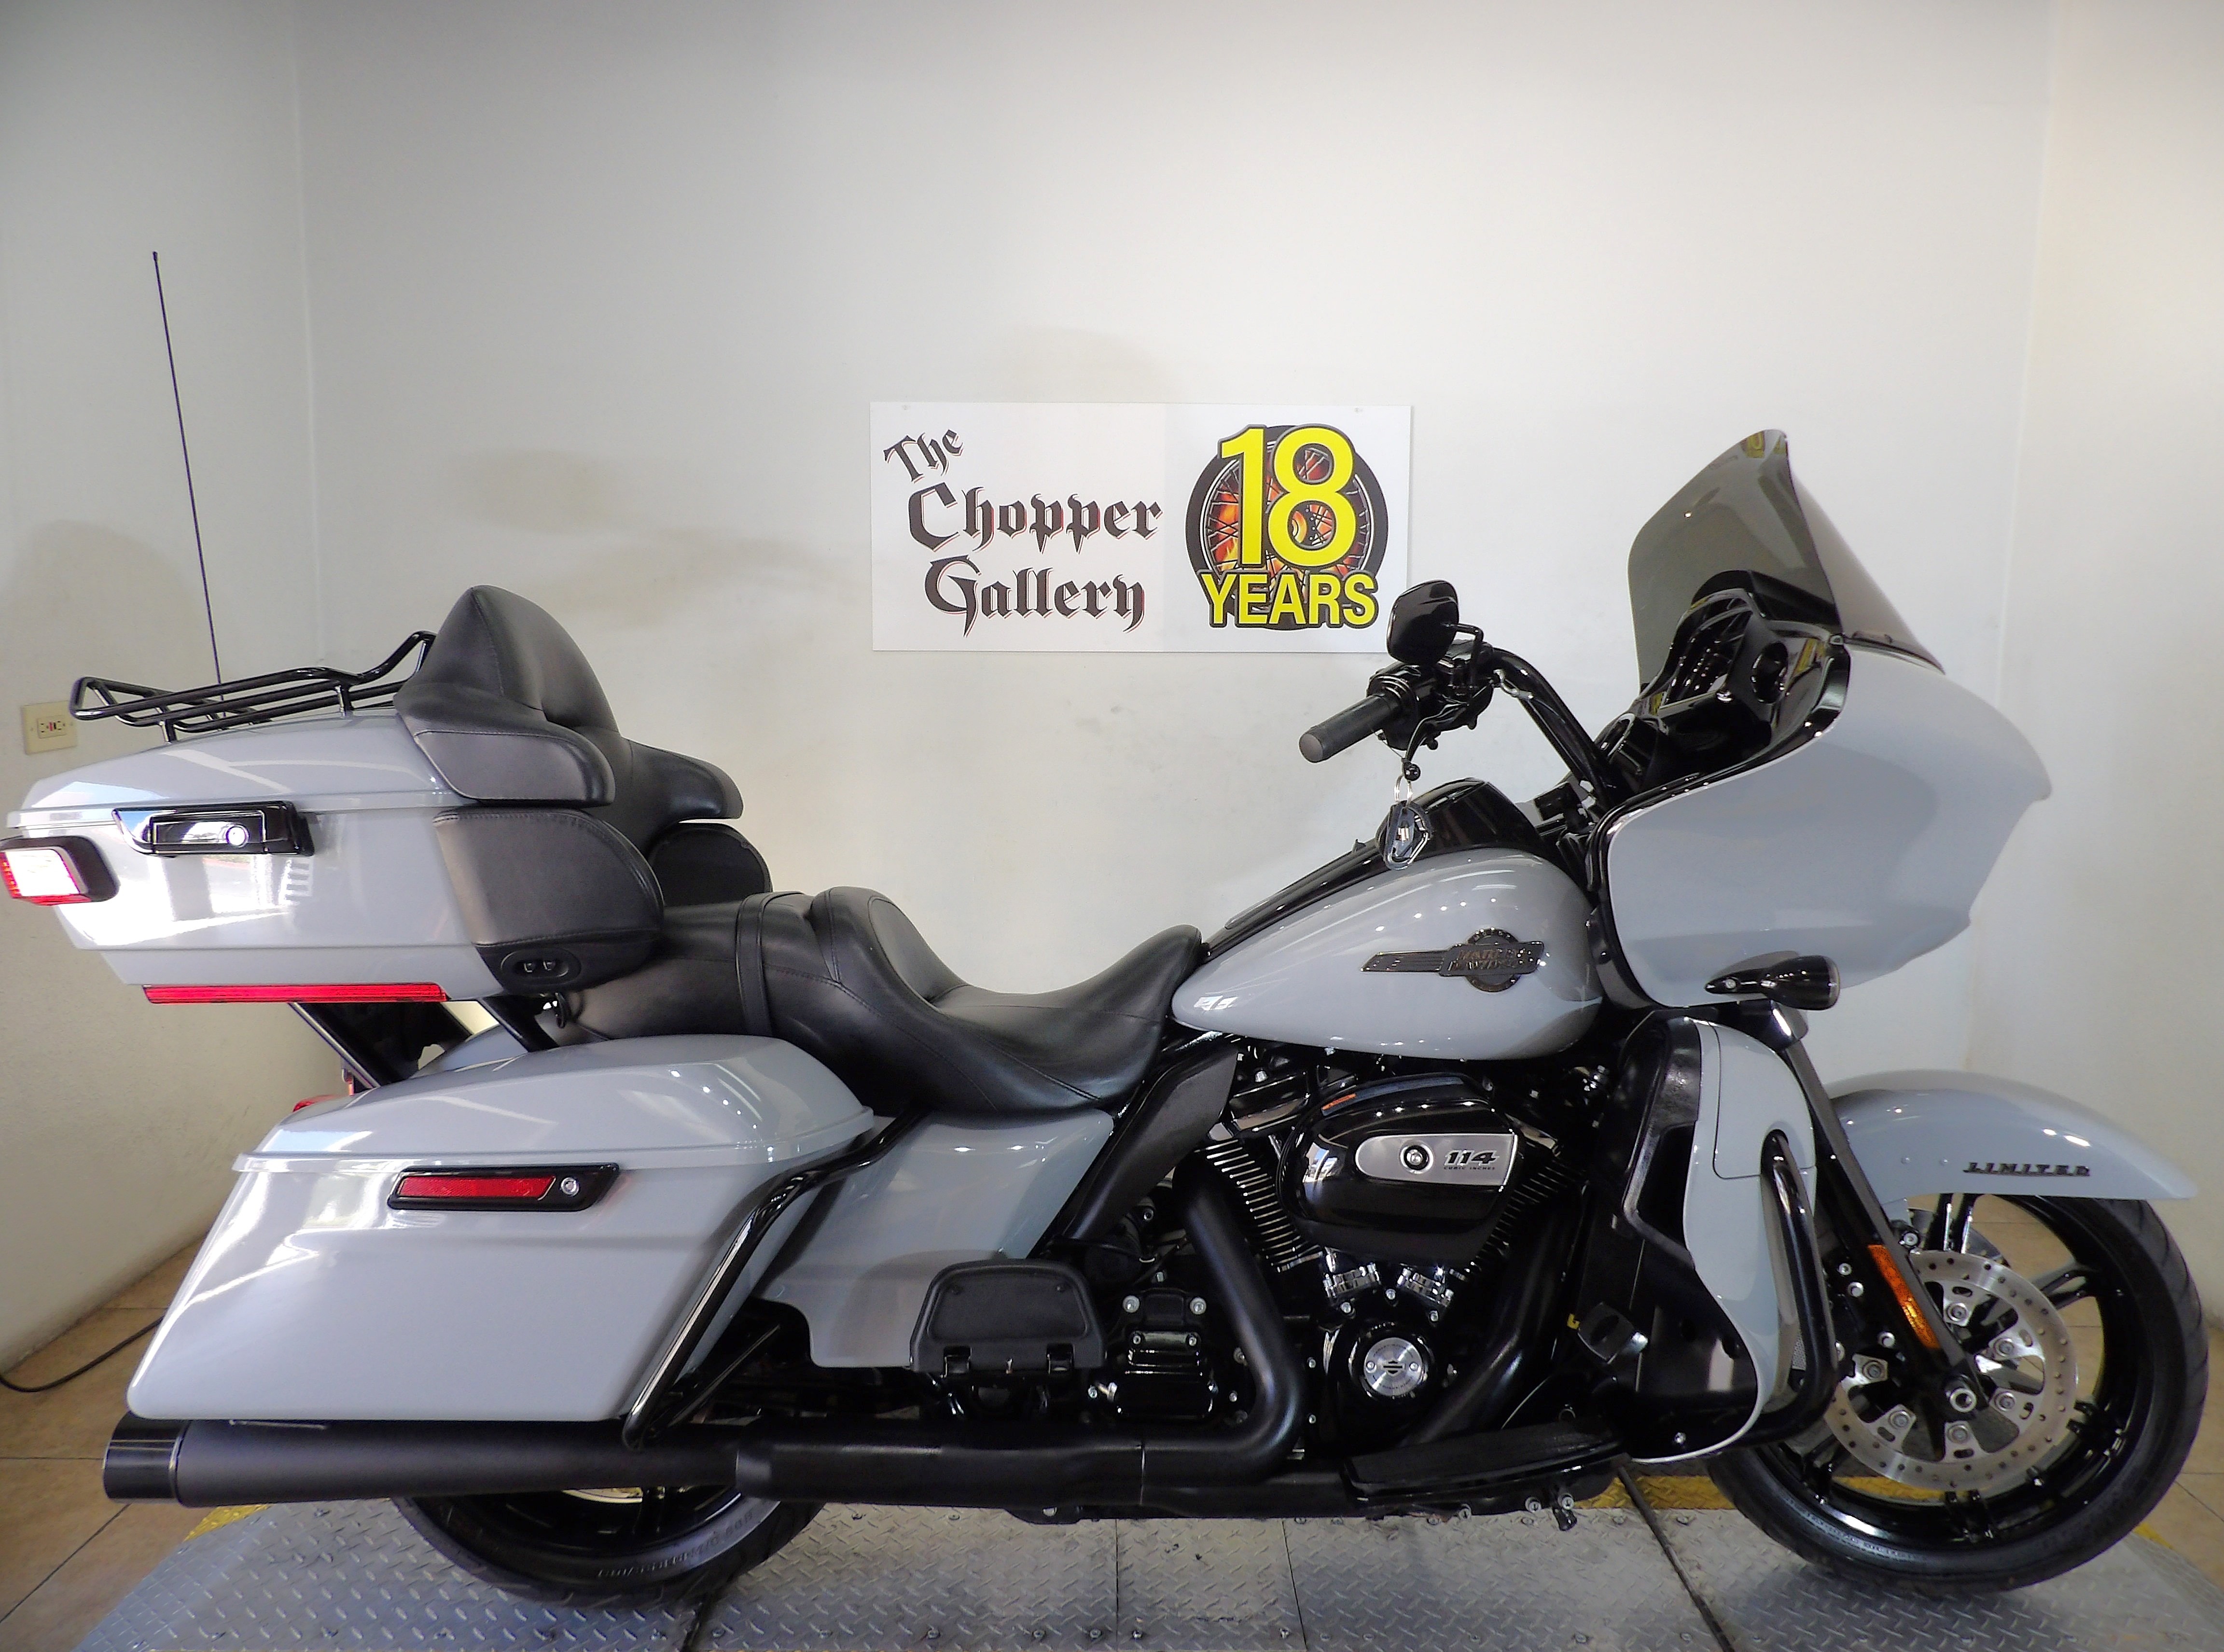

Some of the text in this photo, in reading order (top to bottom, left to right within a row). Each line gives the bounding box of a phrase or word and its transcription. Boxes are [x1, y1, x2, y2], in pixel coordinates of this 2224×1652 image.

[883, 428, 962, 482] The
[908, 482, 1162, 554] Chopper
[1220, 427, 1358, 568] 18
[925, 554, 1145, 637] Gallery
[1201, 573, 1376, 625] YEARS
[1444, 1150, 1500, 1166] 114
[1962, 1162, 2090, 1177] LIMITED
